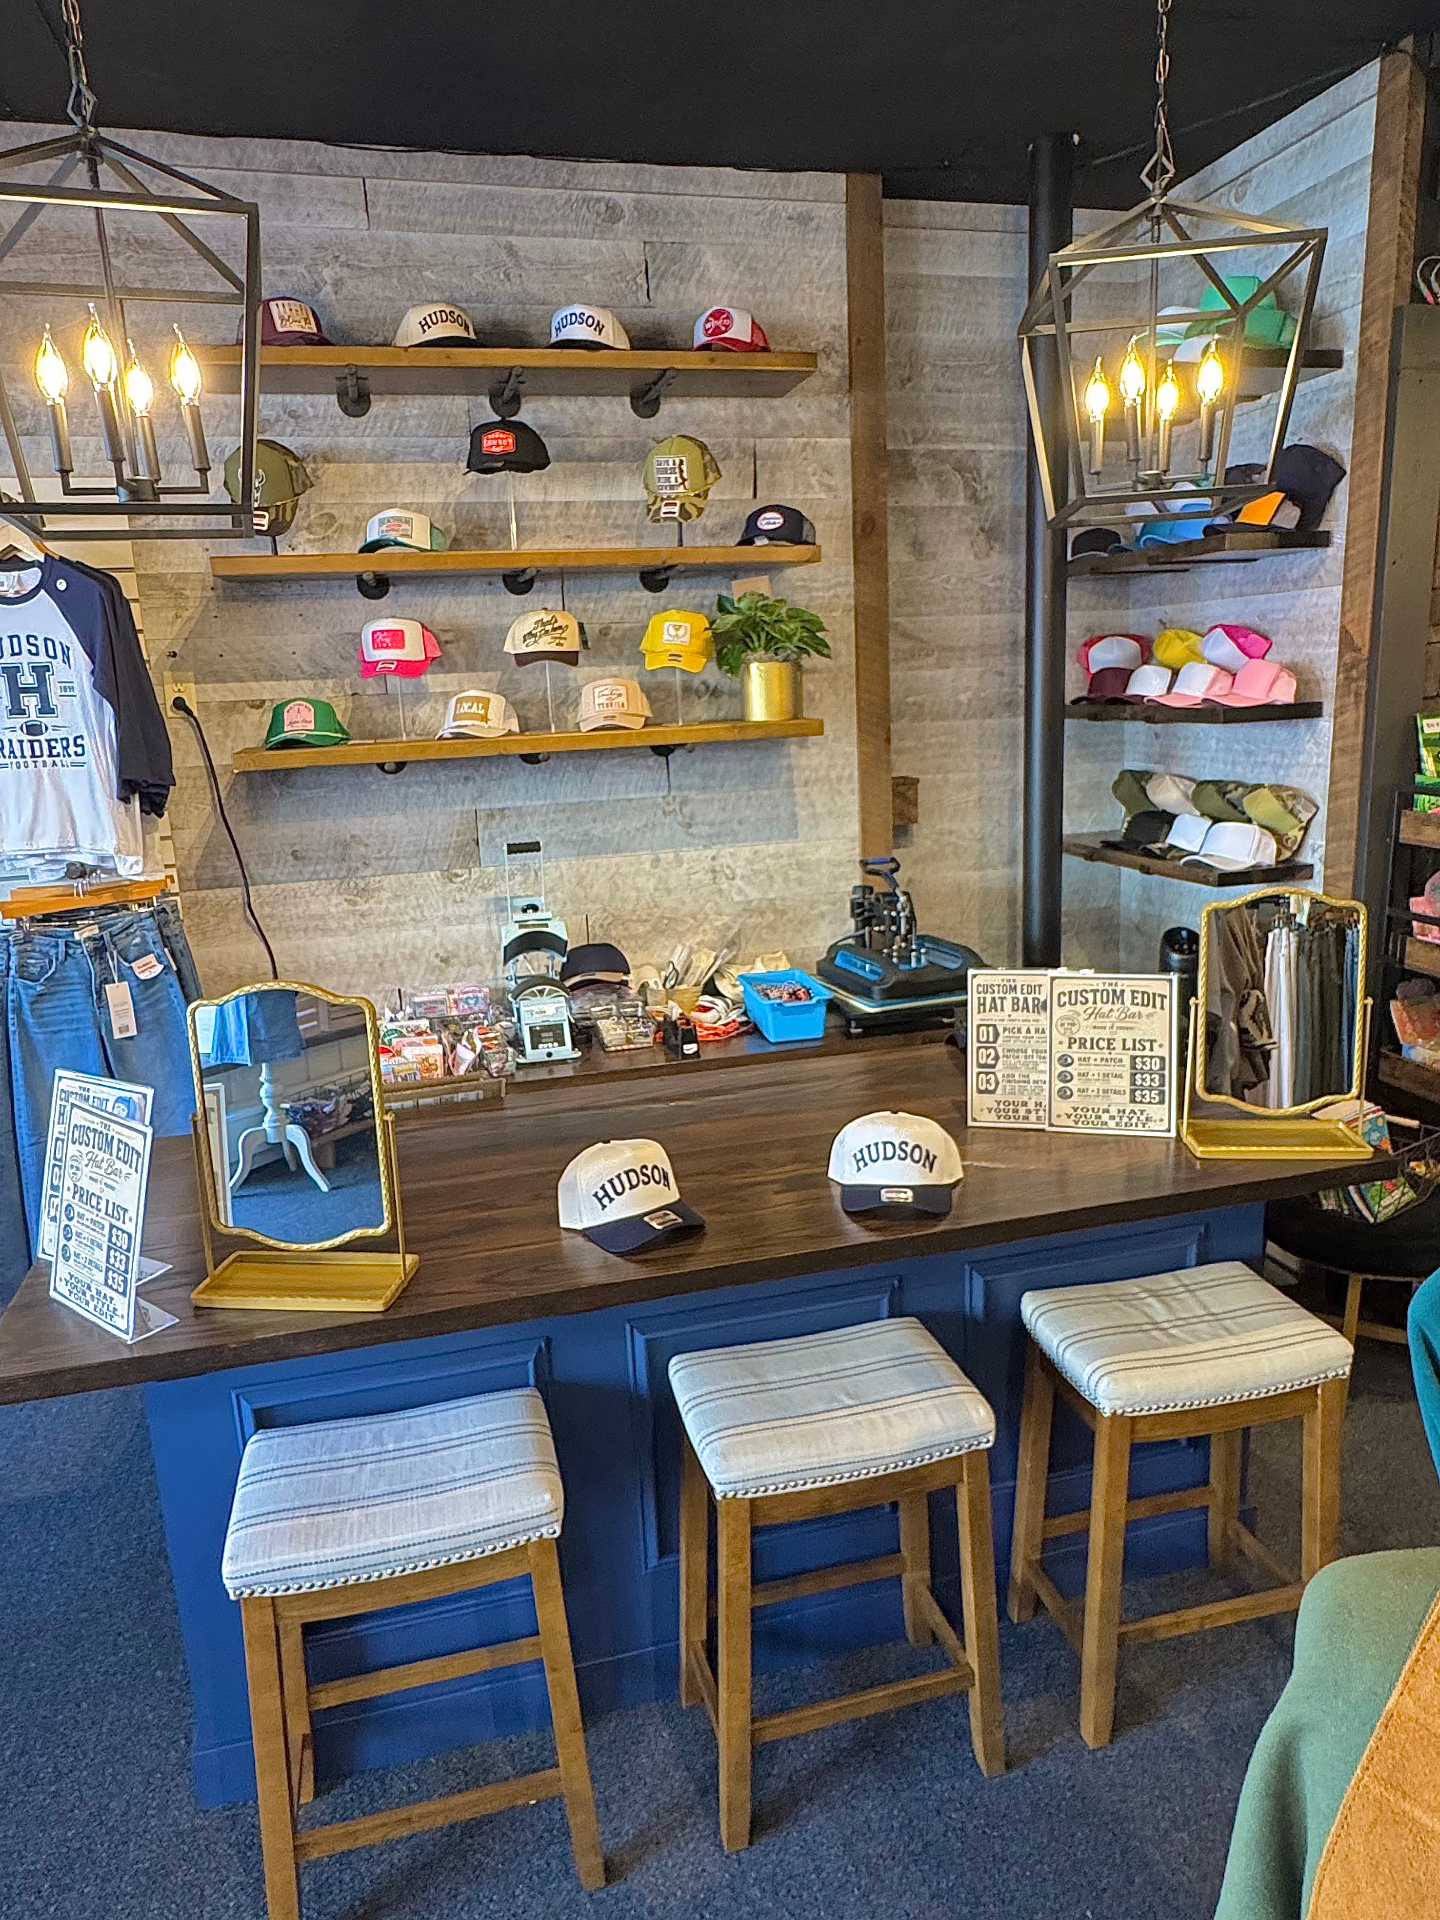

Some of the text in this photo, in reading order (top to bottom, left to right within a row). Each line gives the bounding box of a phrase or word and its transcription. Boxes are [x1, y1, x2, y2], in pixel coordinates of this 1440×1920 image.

[418, 309, 470, 336] HUDSON
[554, 311, 606, 338] HUDSON
[0, 634, 71, 670] DSON
[0, 661, 59, 719] H
[456, 701, 485, 714] LOCAL
[976, 983, 1043, 995] CUSTOM EDIT
[976, 996, 1041, 1015] HAT BAR
[1057, 988, 1168, 1011] CUSTOM EDIT
[1083, 1005, 1144, 1021] Hat Bar
[979, 1025, 994, 1043] 01
[1002, 1026, 1022, 1035] PICK
[1025, 1026, 1031, 1035] A
[1067, 1036, 1157, 1052] PRICE LIST
[978, 1048, 996, 1065] 02
[1135, 1057, 1160, 1071] $30
[978, 1073, 996, 1090] 03
[1102, 1072, 1124, 1080] DETAIL
[1134, 1073, 1160, 1087] $33
[1102, 1088, 1127, 1096] DETAILS
[1134, 1089, 1160, 1104] $35
[986, 1106, 1019, 1114] YOUR
[994, 1099, 1029, 1108] YOUR
[1070, 1106, 1111, 1114] YOUR
[1064, 1113, 1103, 1121] YOUR
[1072, 1119, 1109, 1127] YOUR
[71, 1124, 115, 1157] CUSTOM
[116, 1137, 142, 1174] EDIT
[852, 1140, 938, 1173] HUDSON
[592, 1163, 671, 1211] HUDSON
[72, 1182, 102, 1212] PRICE
[104, 1198, 128, 1225] LIST
[111, 1227, 128, 1250] $30
[109, 1248, 126, 1271] $33
[64, 1277, 88, 1298] YOUR
[68, 1271, 93, 1292] YOUR
[108, 1269, 124, 1293] $35
[68, 1288, 90, 1307] YOUR
